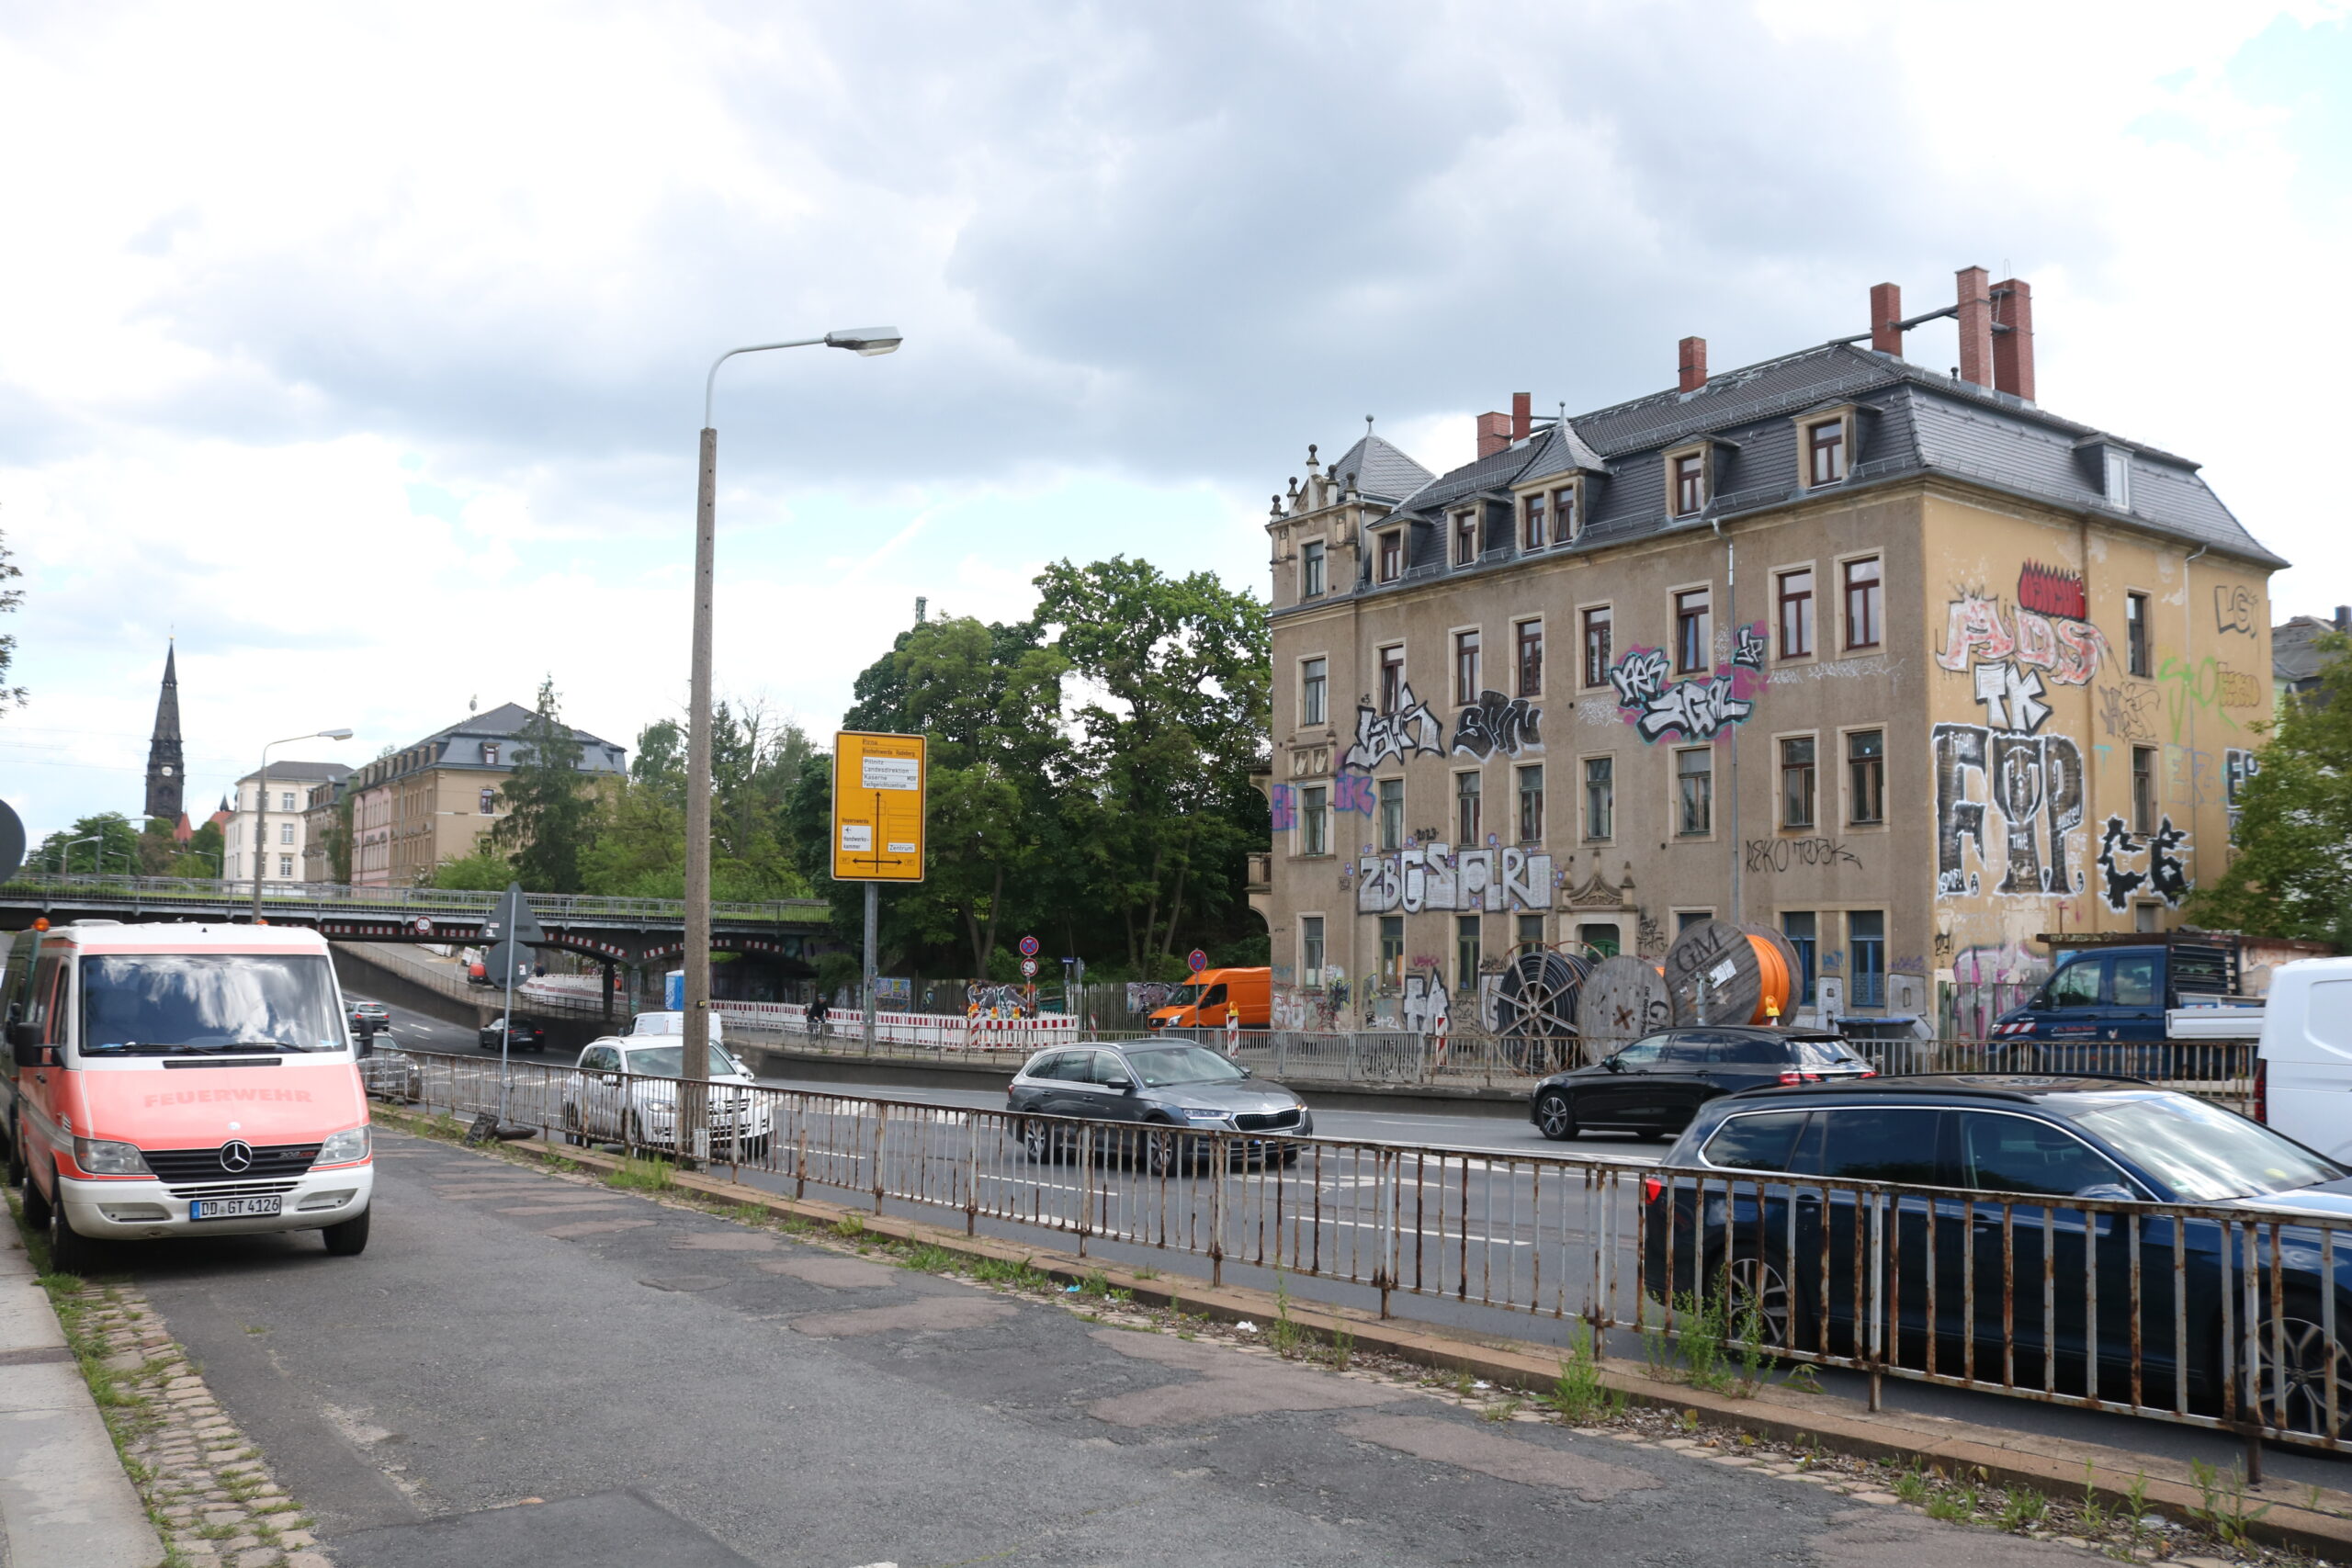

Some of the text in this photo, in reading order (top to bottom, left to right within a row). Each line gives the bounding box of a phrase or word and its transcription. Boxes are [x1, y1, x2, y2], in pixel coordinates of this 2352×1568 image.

[864, 766, 910, 774] Landesdirektion
[888, 844, 914, 852] Zentrum
[1676, 924, 1723, 974] GM
[144, 1088, 314, 1109] FEUERWEHR
[201, 1197, 279, 1216] DD GT 4126
